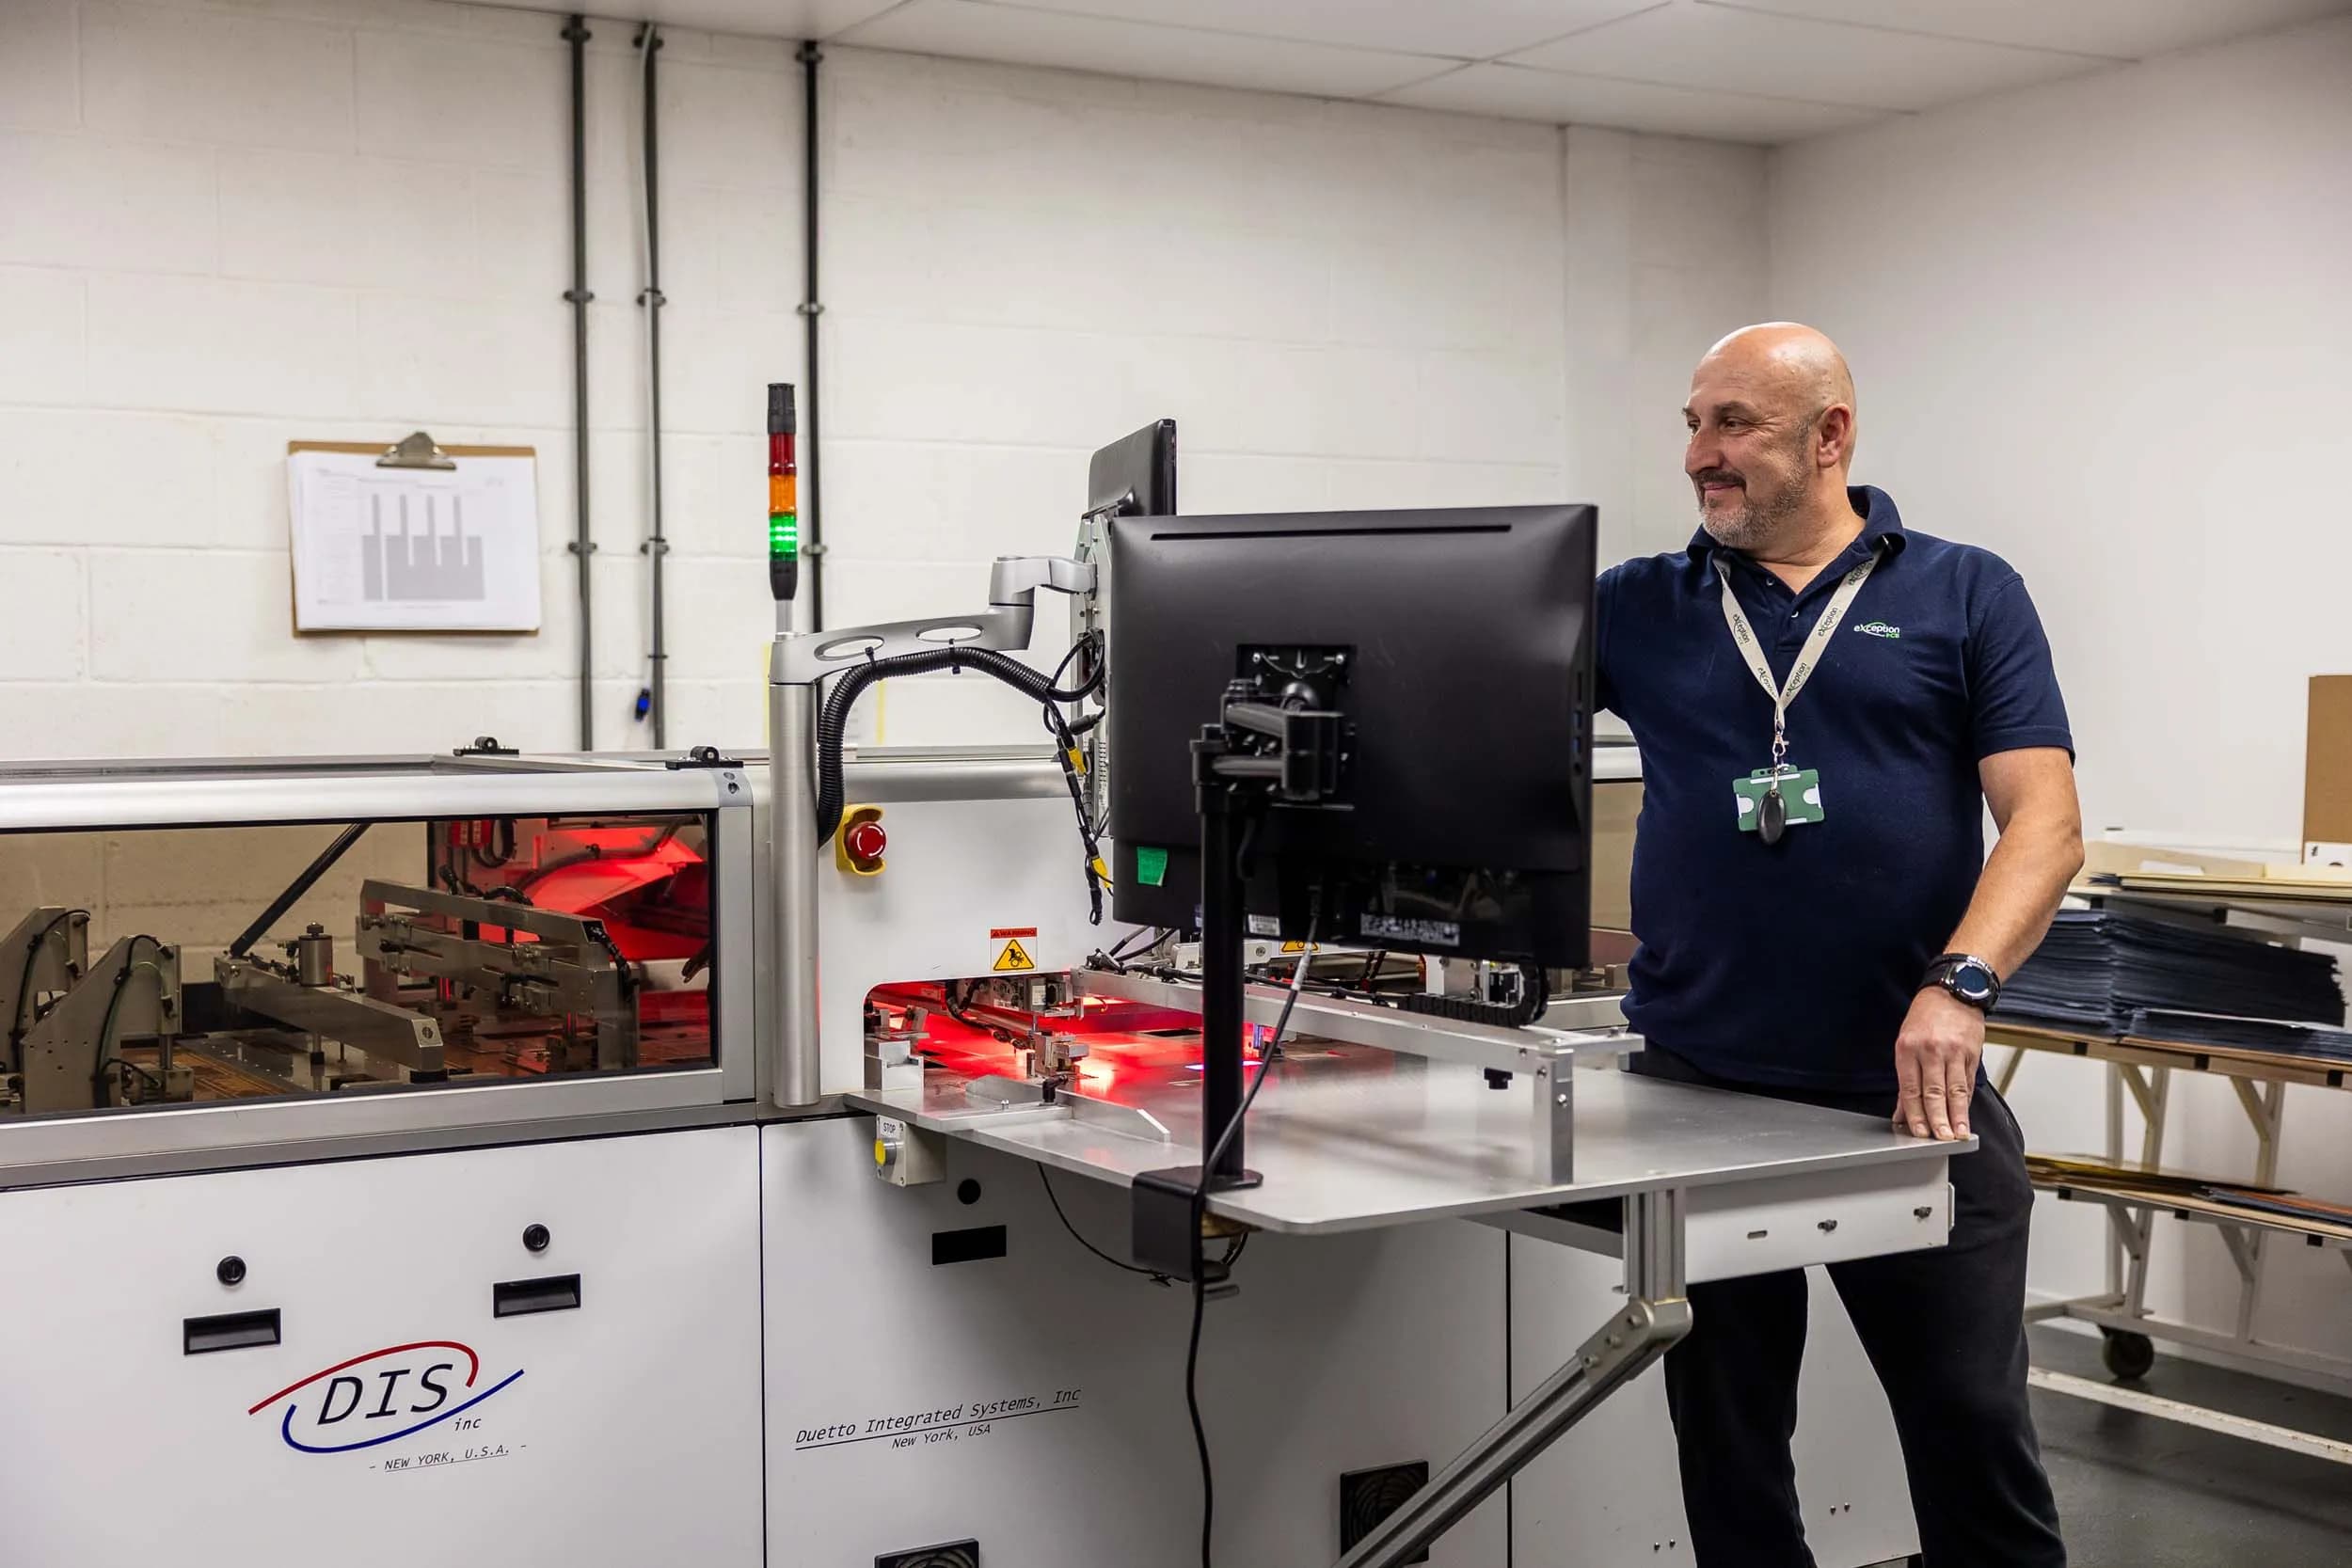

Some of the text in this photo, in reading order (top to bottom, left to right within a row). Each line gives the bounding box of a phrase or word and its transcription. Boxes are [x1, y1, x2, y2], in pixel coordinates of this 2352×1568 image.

[882, 1122, 897, 1133] STOP
[317, 1364, 453, 1425] DIS
[455, 1417, 482, 1432] inc
[796, 1387, 1081, 1444] Duetto Integrated Systems, Inc
[892, 1424, 992, 1449] New York, USA
[384, 1444, 510, 1471] NEW YORK, U.S.A.
